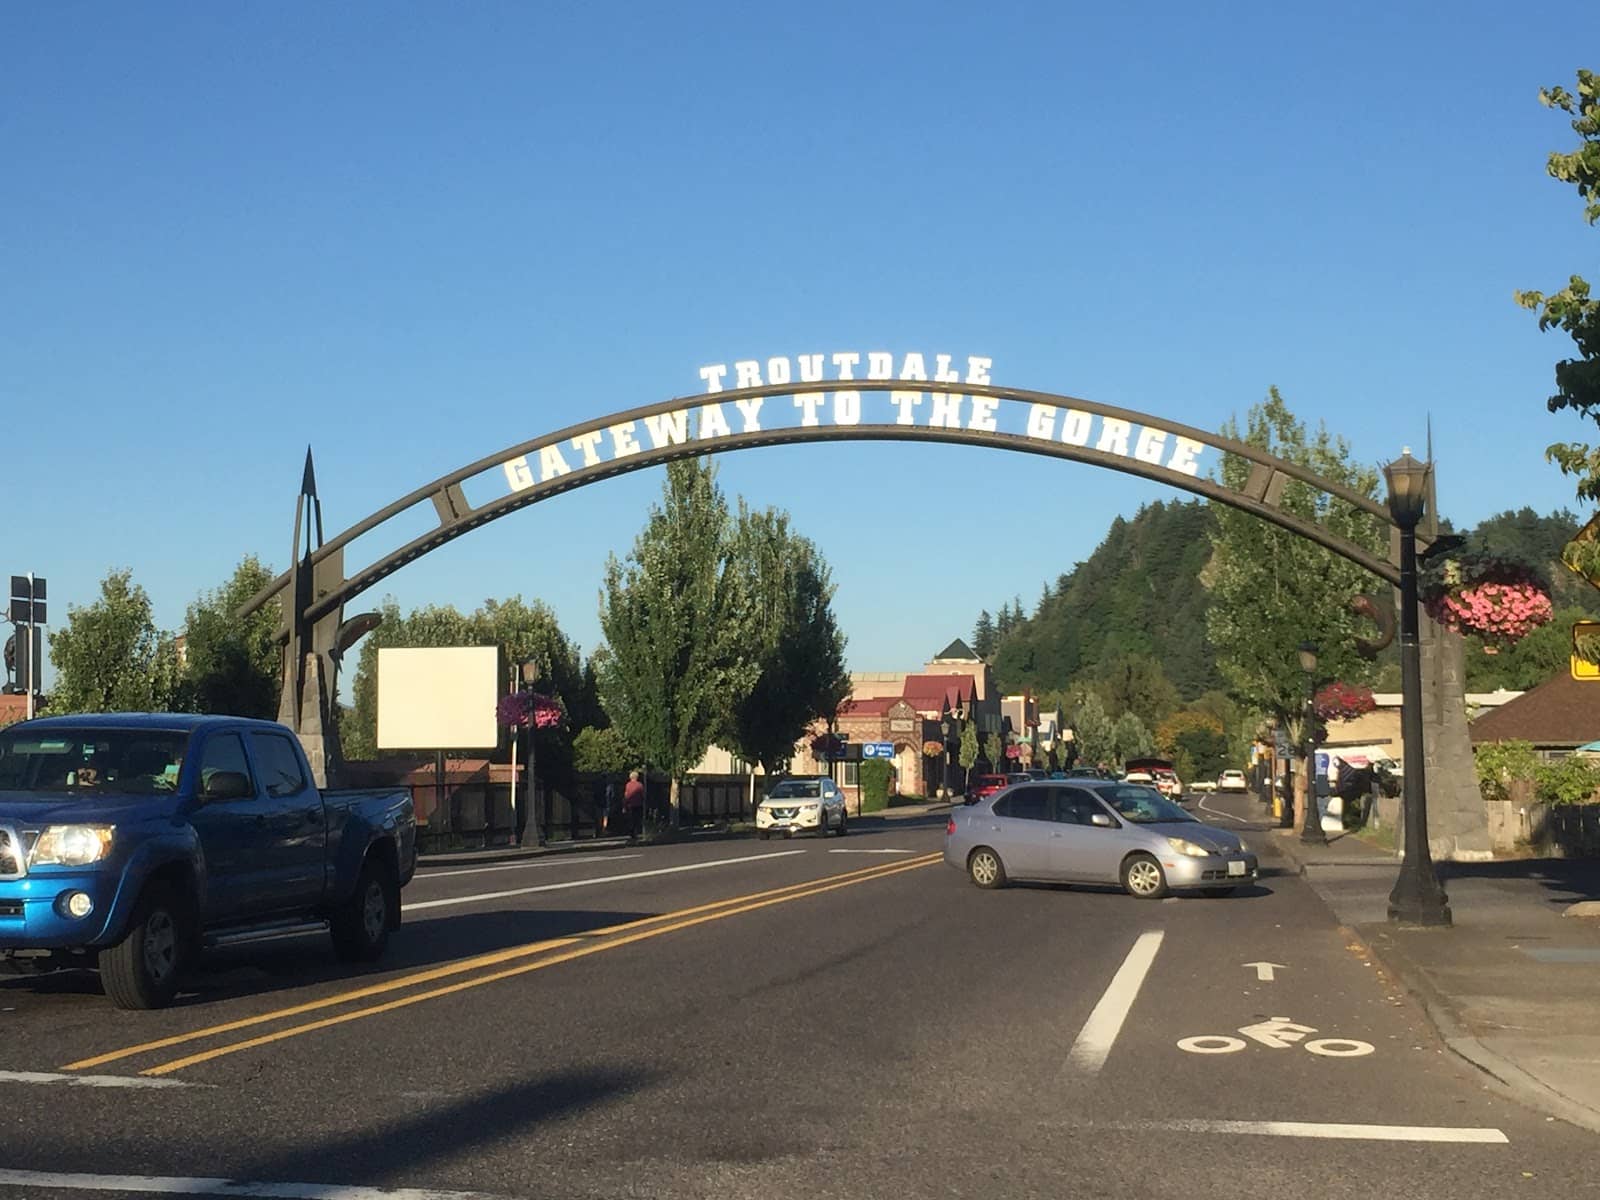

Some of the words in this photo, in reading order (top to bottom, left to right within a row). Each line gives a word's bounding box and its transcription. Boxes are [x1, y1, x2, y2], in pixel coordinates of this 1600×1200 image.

[700, 352, 993, 394] TROUTDALE
[503, 397, 764, 492] GATEWAY
[794, 390, 861, 427] TO
[889, 390, 1000, 433] THE
[1026, 403, 1205, 477] GORGE
